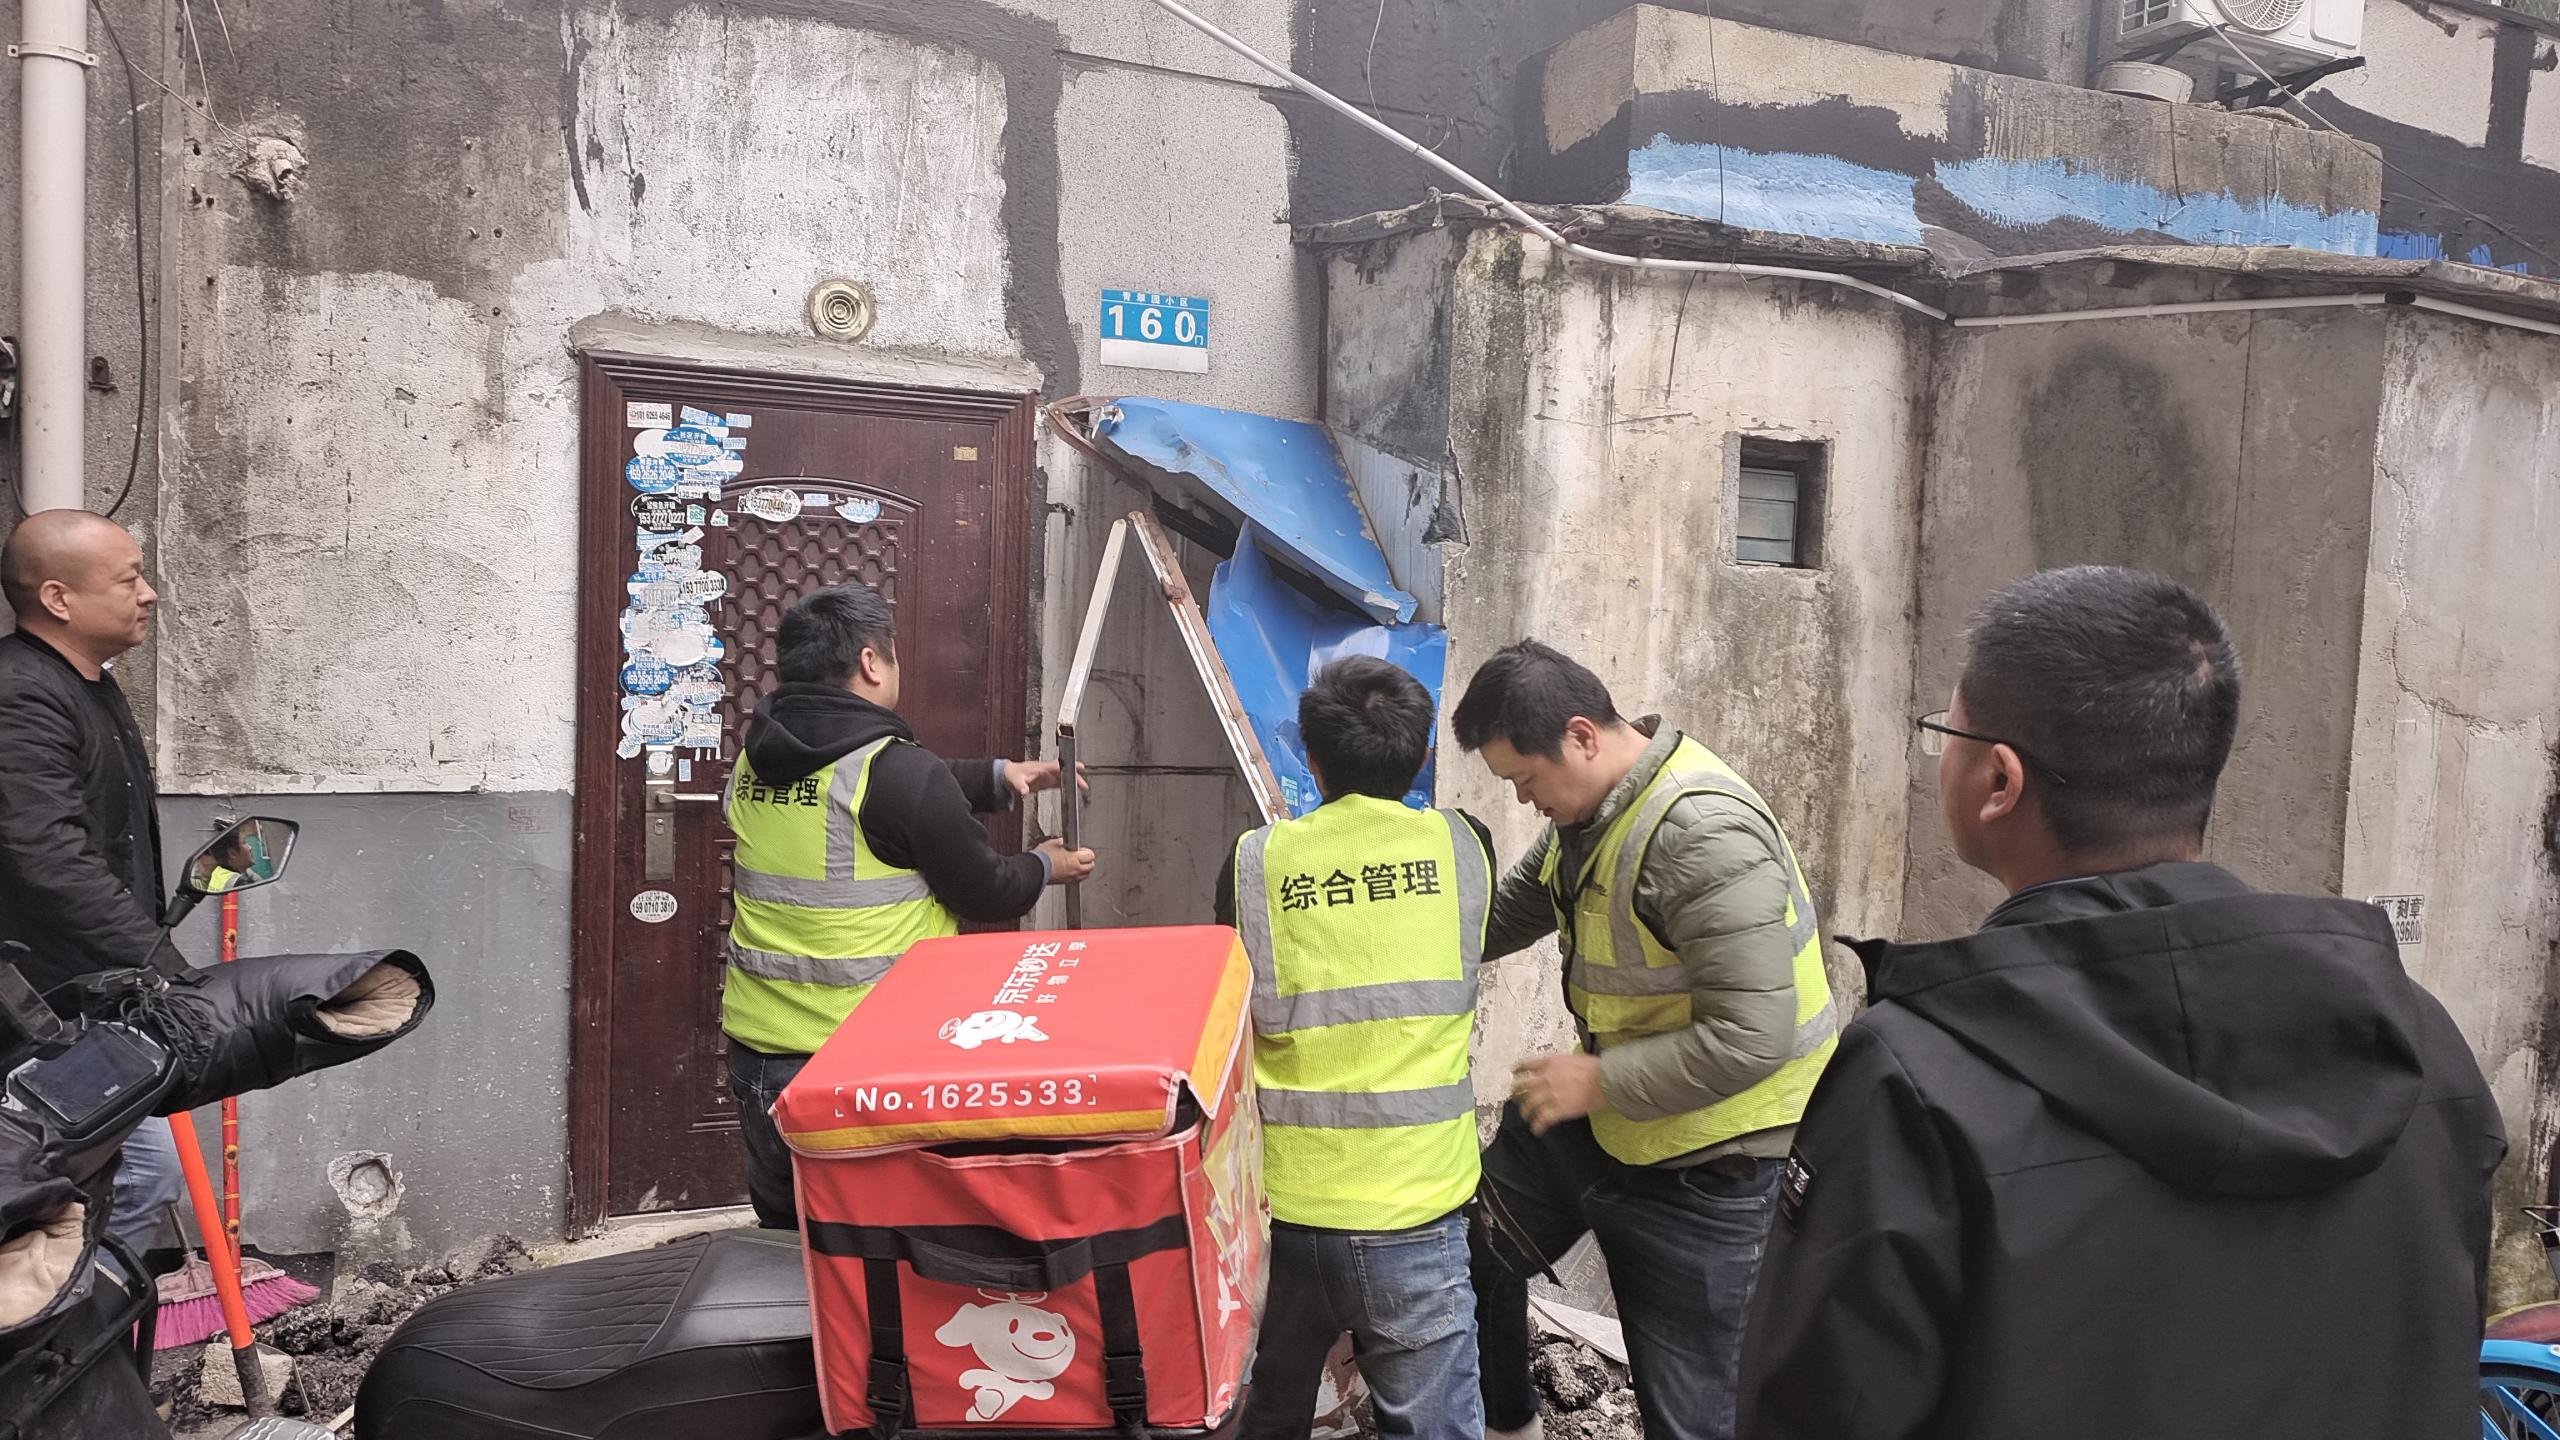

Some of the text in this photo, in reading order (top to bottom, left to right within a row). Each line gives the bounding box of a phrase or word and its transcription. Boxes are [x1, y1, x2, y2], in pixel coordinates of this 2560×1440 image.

[1108, 304, 1196, 342] 160
[1279, 858, 1441, 912] 综合管理
[632, 902, 643, 914] 159
[2396, 896, 2423, 920] 刻章
[992, 941, 1062, 1005] 京东秒送
